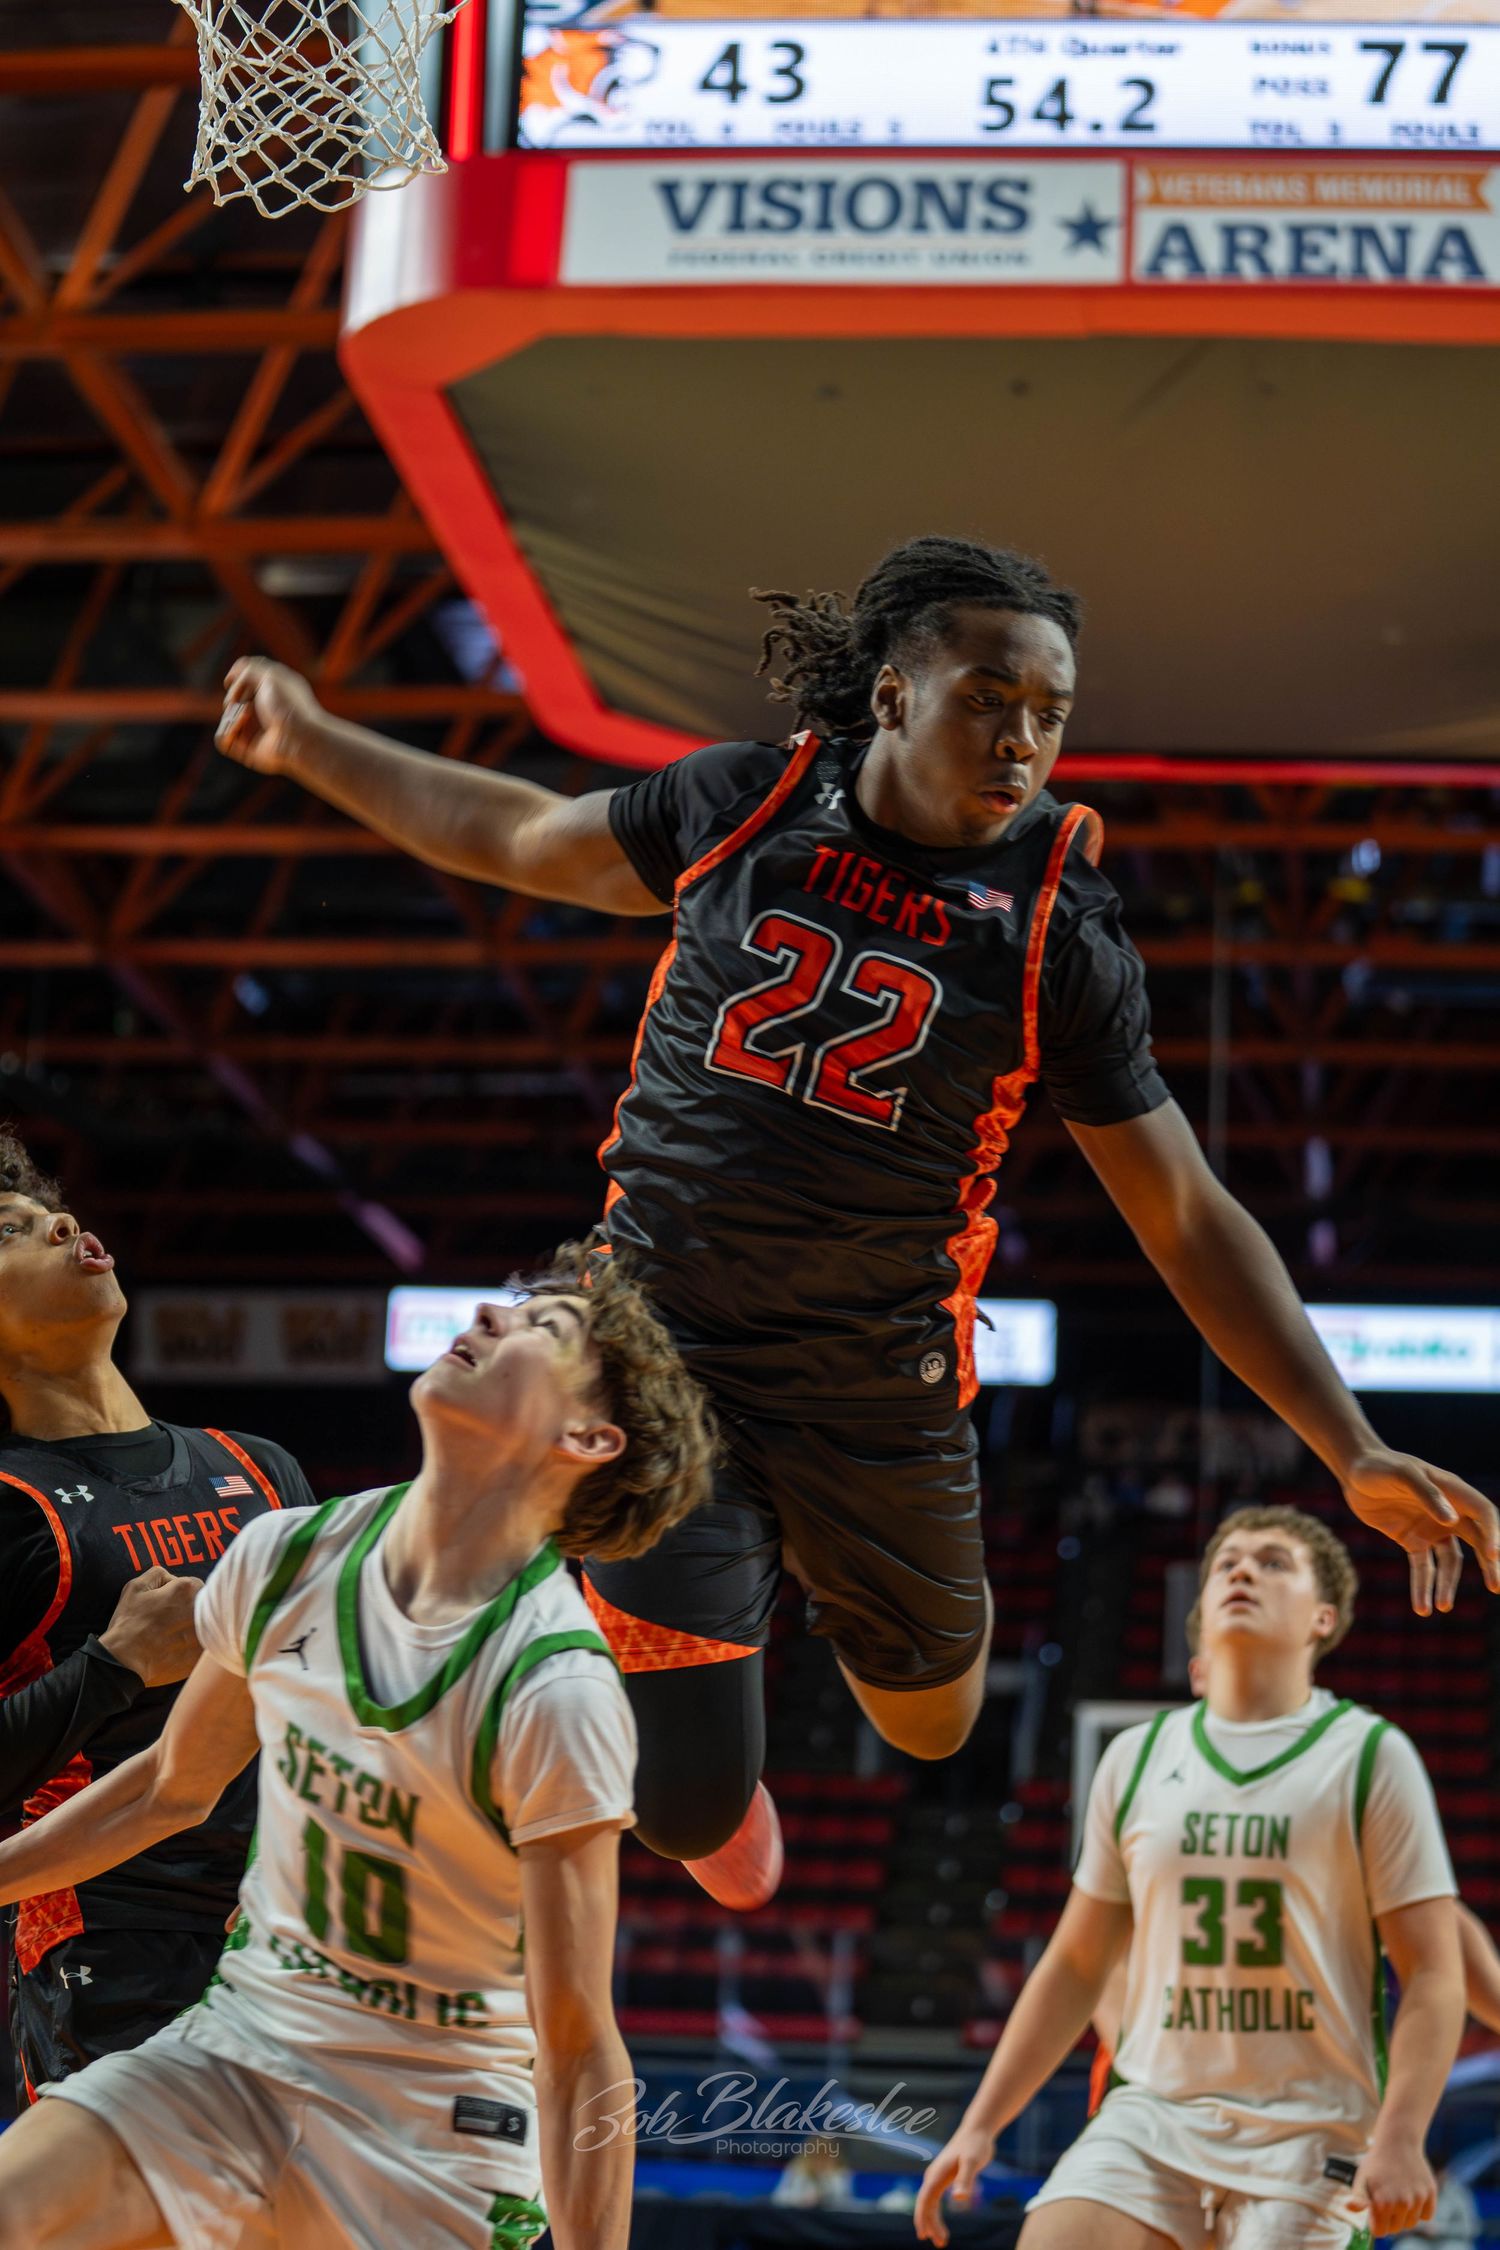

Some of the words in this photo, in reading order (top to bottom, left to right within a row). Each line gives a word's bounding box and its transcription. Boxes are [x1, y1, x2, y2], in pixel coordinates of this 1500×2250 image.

[700, 40, 805, 103] 43
[1359, 40, 1469, 104] 77
[982, 77, 1156, 132] 54.2
[656, 176, 1030, 234] VISIONS
[1145, 220, 1486, 278] ARENA
[802, 844, 952, 947] TIGERS
[703, 908, 945, 1132] 22
[277, 1720, 421, 1849] SETON
[1180, 1810, 1291, 1860] SETON
[303, 1813, 411, 1966] 10
[1180, 1875, 1285, 1968] 33
